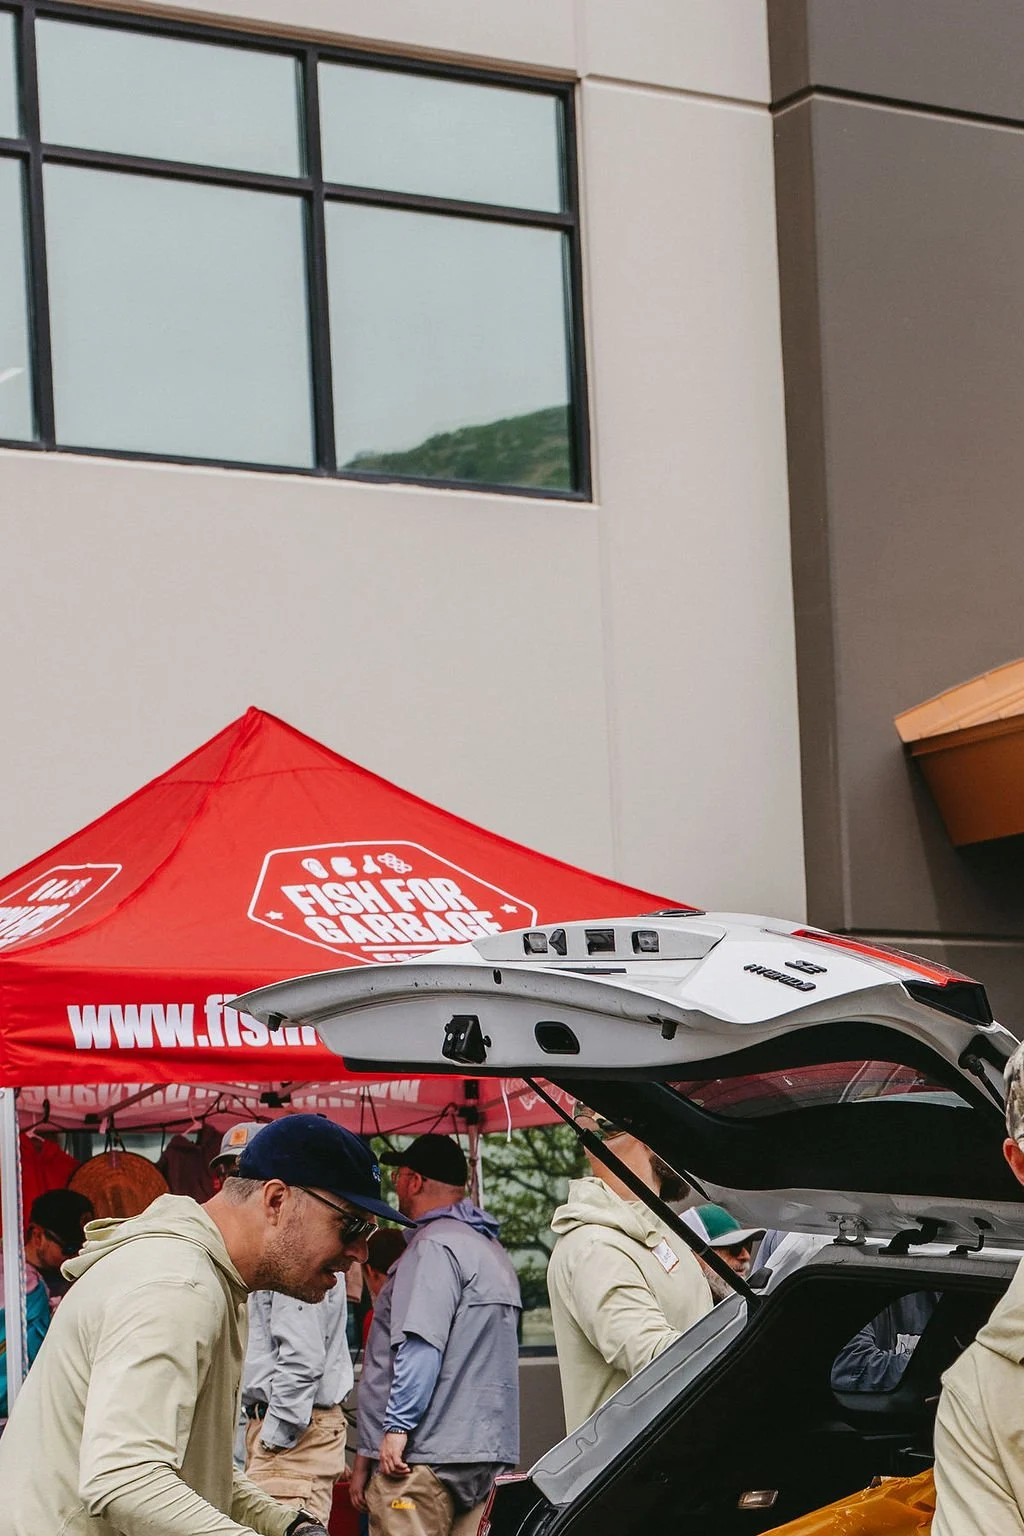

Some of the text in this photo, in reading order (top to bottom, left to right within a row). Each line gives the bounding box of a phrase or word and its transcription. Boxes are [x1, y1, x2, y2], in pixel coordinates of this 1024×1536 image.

[280, 877, 478, 916] FISH FOR
[303, 911, 503, 944] GARBAGE
